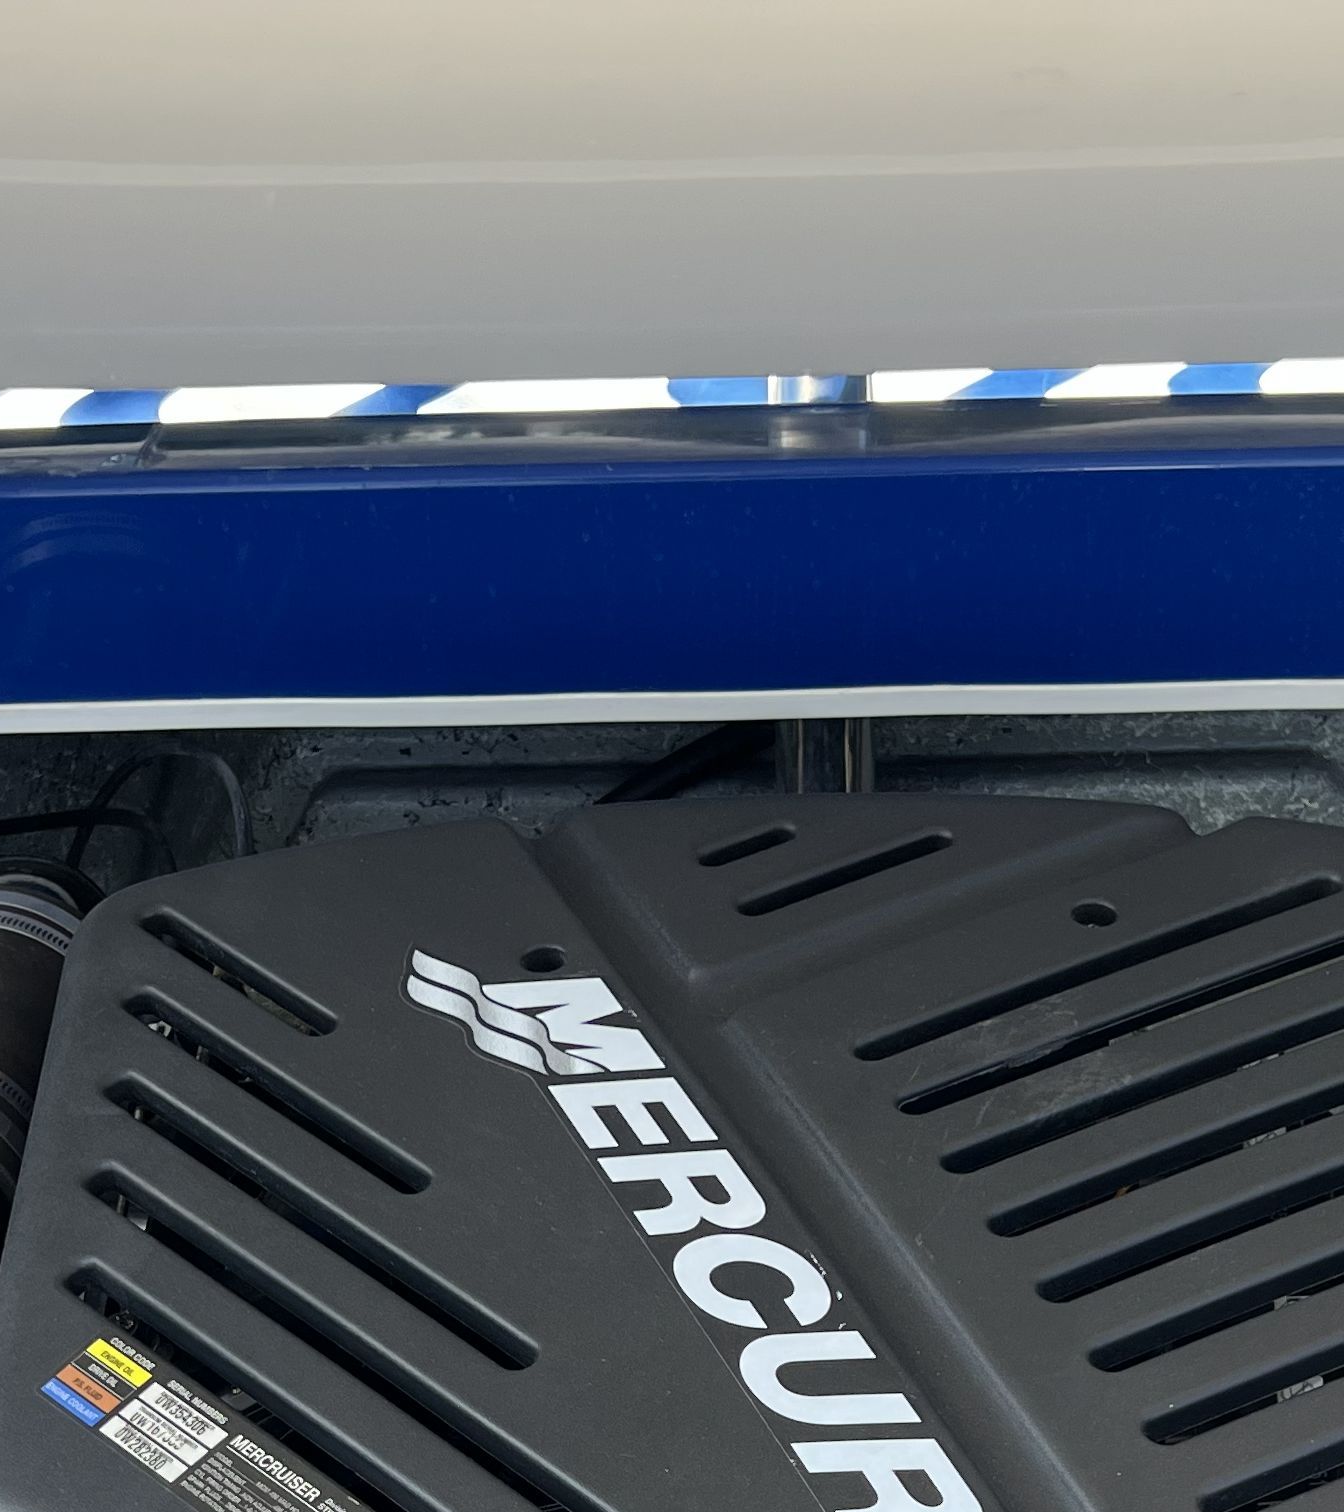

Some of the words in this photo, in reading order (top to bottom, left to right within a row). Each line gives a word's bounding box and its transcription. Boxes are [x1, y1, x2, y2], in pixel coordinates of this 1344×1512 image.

[99, 1349, 124, 1368] ENGINE
[121, 1365, 135, 1376] OIL
[109, 1336, 136, 1356] COLOR
[132, 1353, 156, 1371] CODE
[86, 1362, 110, 1380] DRIVE
[105, 1376, 119, 1387] OIL
[44, 1381, 71, 1401] ENGINE
[66, 1397, 99, 1421] COOLANT
[166, 1379, 194, 1400] SERIAL
[190, 1396, 229, 1424] NUMBERS
[229, 1433, 322, 1503] MERCRUISER
